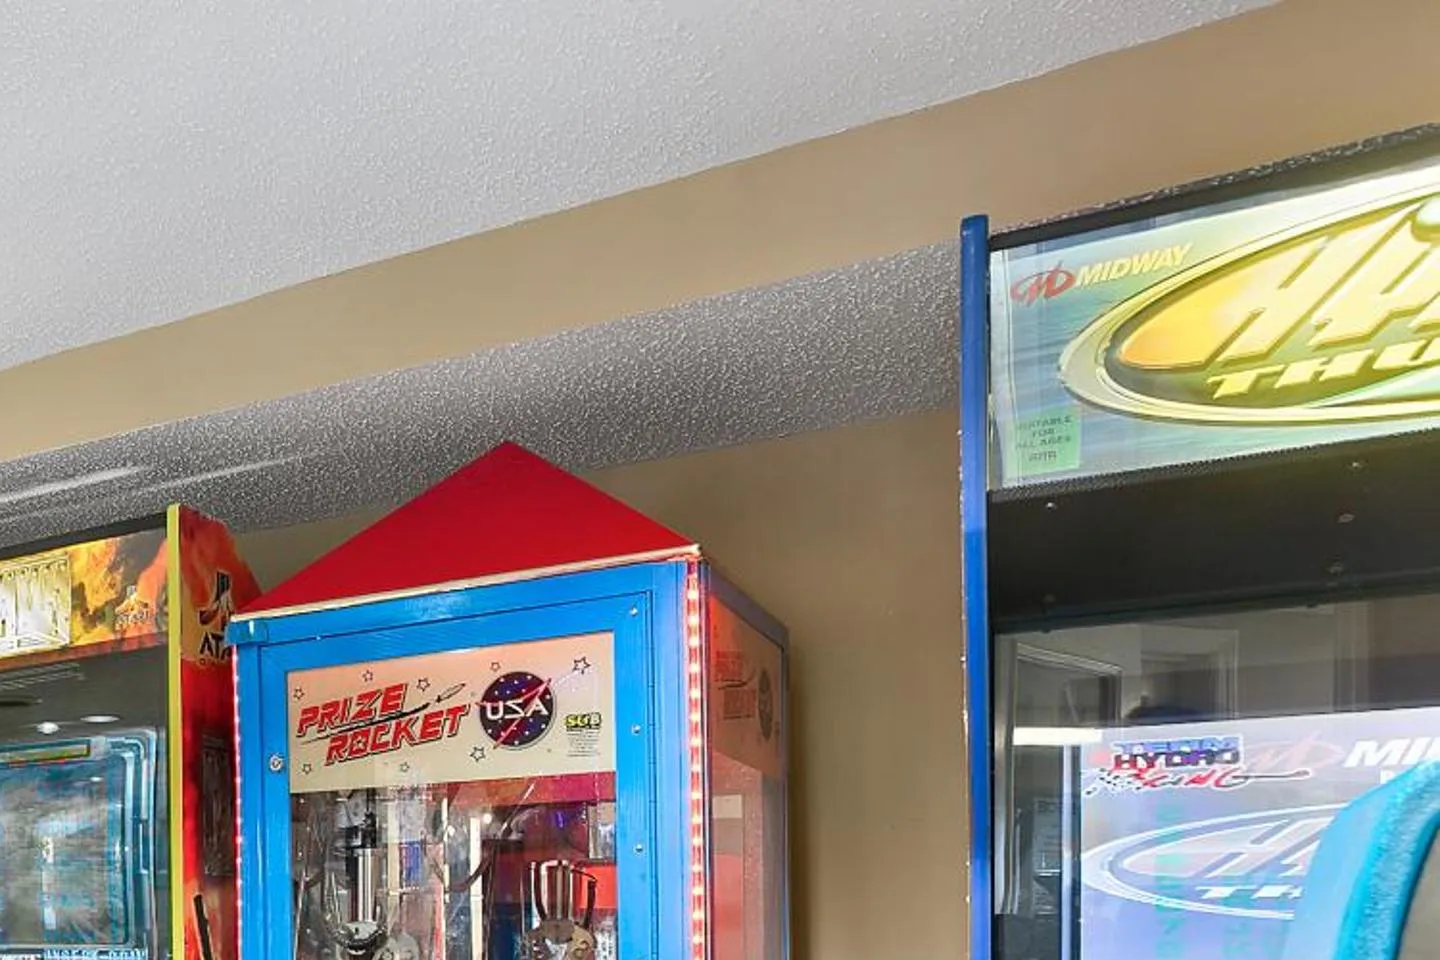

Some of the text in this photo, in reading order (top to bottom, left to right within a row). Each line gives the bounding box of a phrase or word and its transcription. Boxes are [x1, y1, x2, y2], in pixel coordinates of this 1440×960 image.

[1076, 243, 1194, 287] MIDWAY
[296, 683, 408, 738] PRIZE
[486, 698, 550, 721] USA
[323, 703, 471, 767] ROCKET
[1113, 750, 1241, 770] HYDRO
